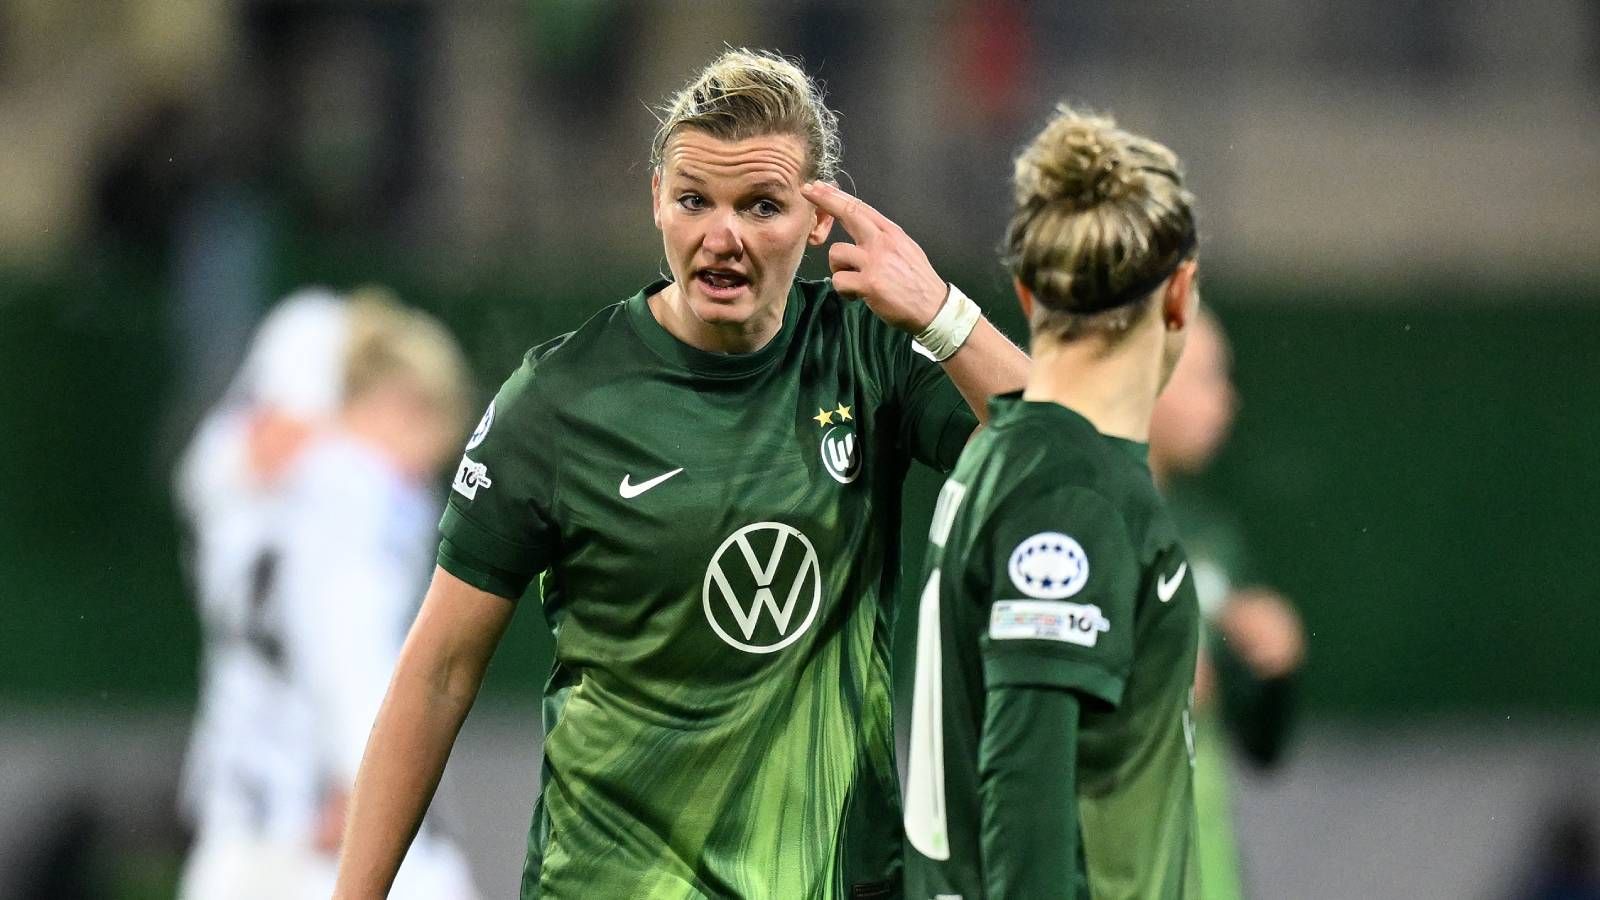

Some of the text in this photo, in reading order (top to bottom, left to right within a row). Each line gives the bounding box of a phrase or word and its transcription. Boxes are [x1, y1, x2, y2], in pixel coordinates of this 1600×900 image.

[461, 466, 478, 488] 10
[708, 527, 815, 641] VW
[1068, 613, 1092, 632] 10
